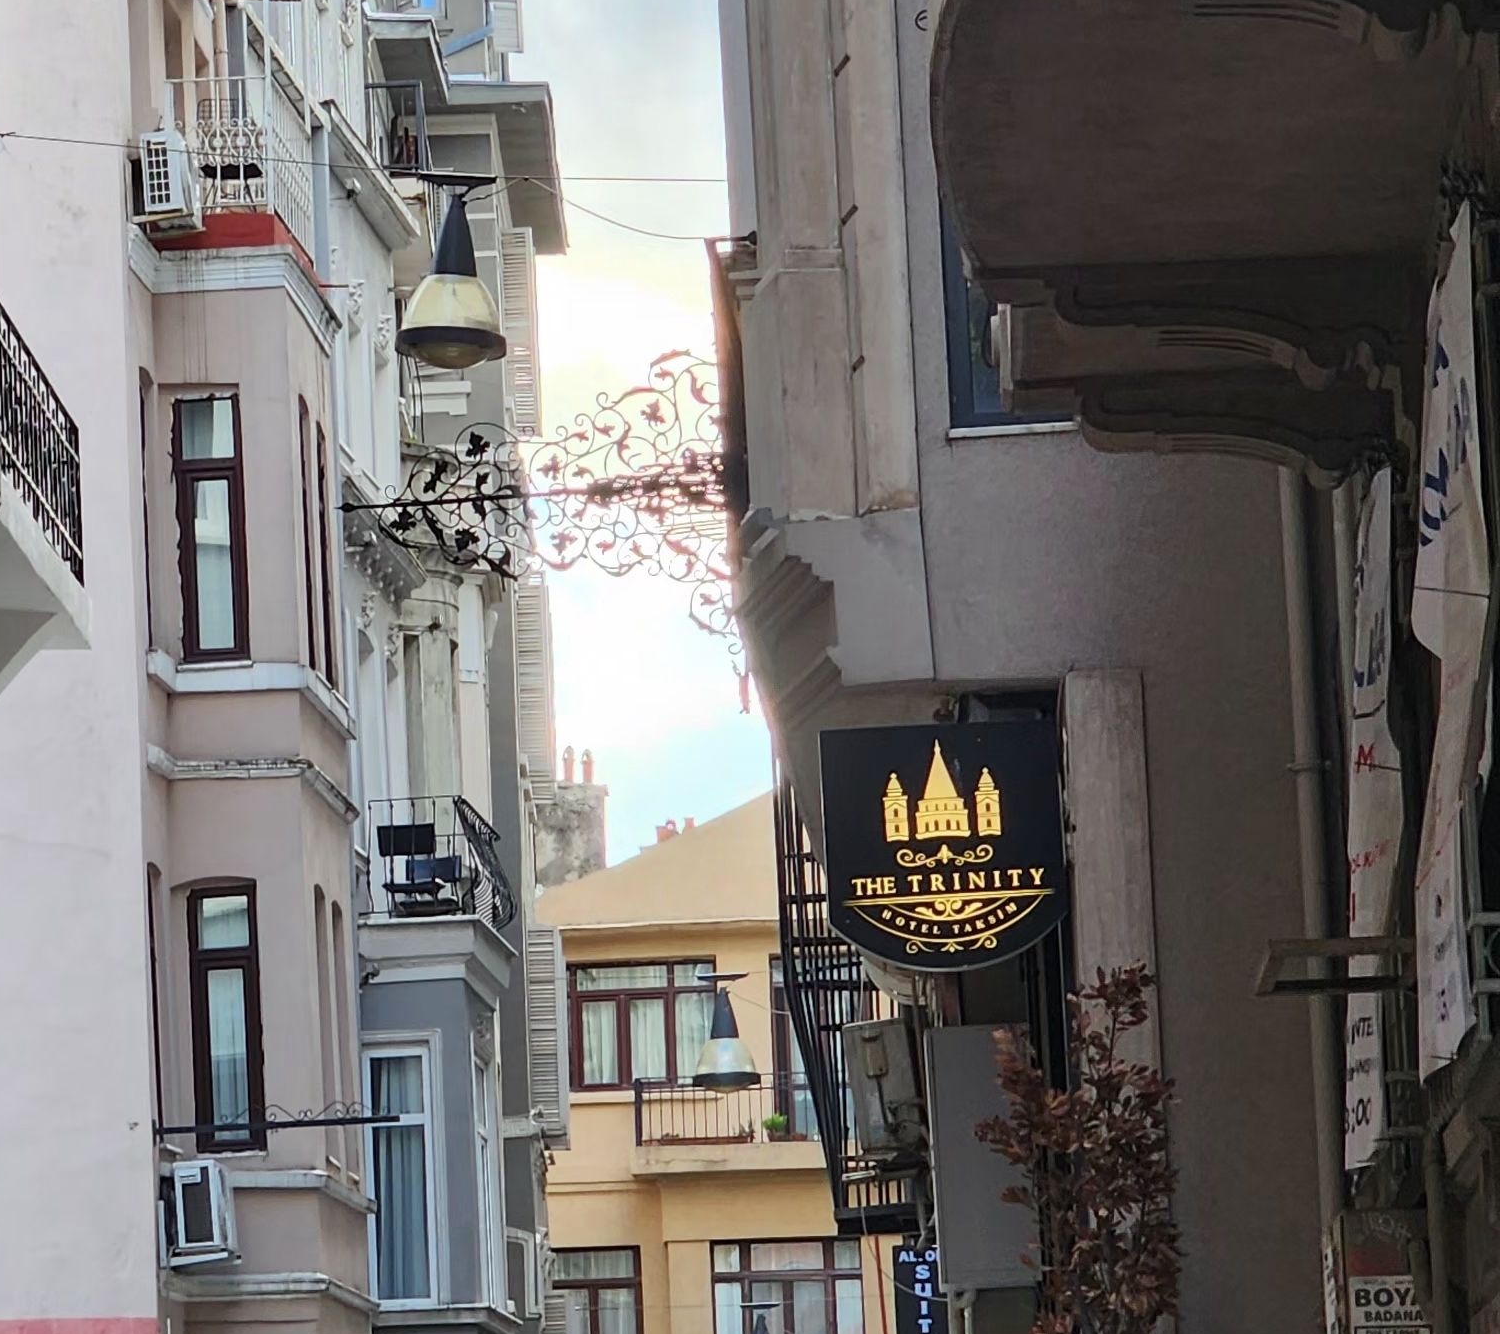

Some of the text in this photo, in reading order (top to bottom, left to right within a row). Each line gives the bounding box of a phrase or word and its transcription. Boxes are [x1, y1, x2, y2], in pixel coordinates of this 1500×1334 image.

[851, 867, 1045, 896] THE TRINITY
[881, 901, 1018, 935] HOTEL TAKSİM
[1364, 1310, 1424, 1322] BADANA
